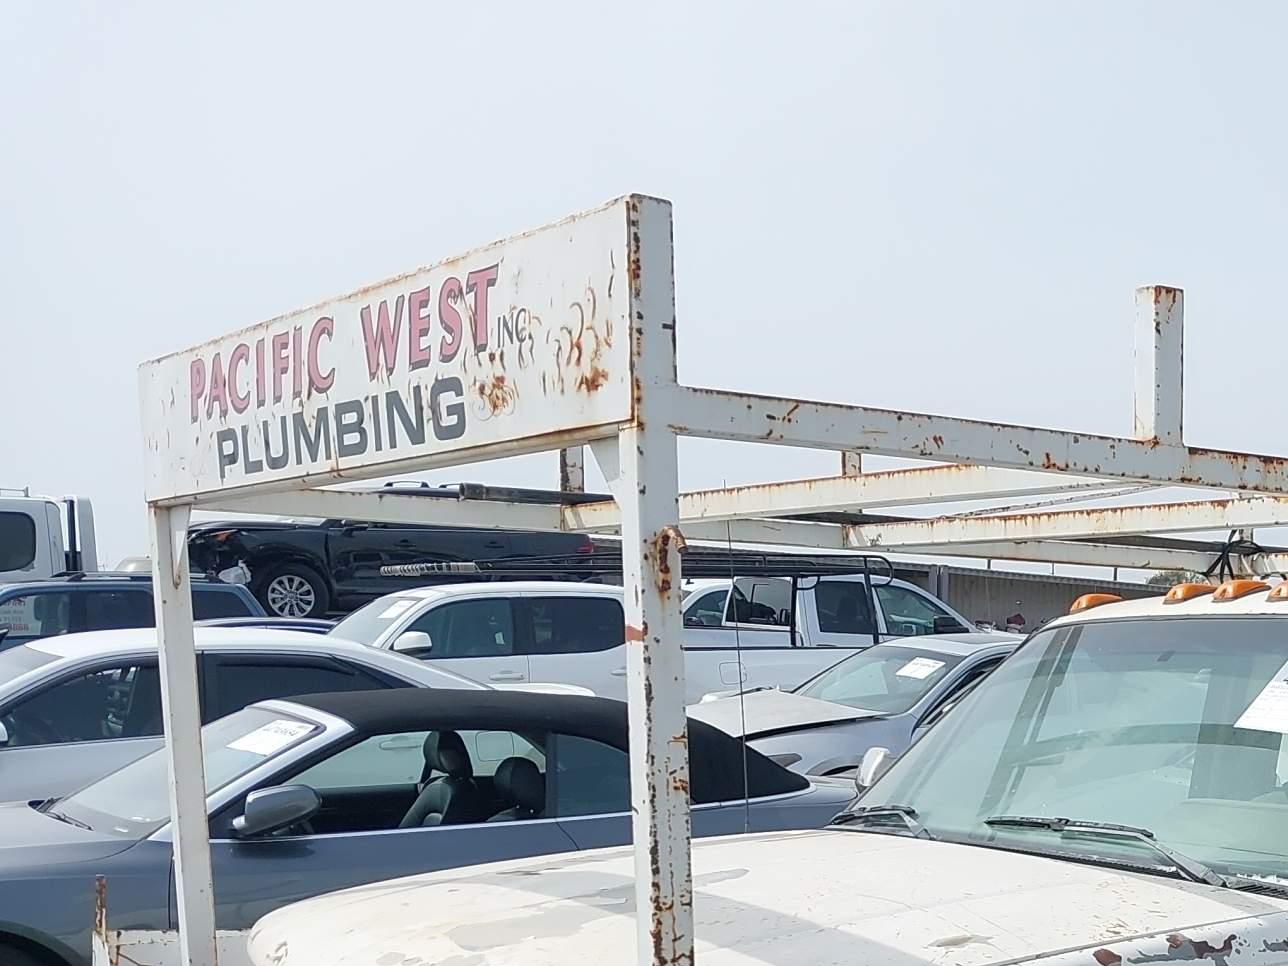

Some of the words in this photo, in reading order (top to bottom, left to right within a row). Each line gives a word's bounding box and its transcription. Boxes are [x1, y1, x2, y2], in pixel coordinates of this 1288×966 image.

[189, 316, 336, 424] PACIFIC
[360, 263, 499, 381] WEST
[216, 376, 467, 479] PLUMBING
